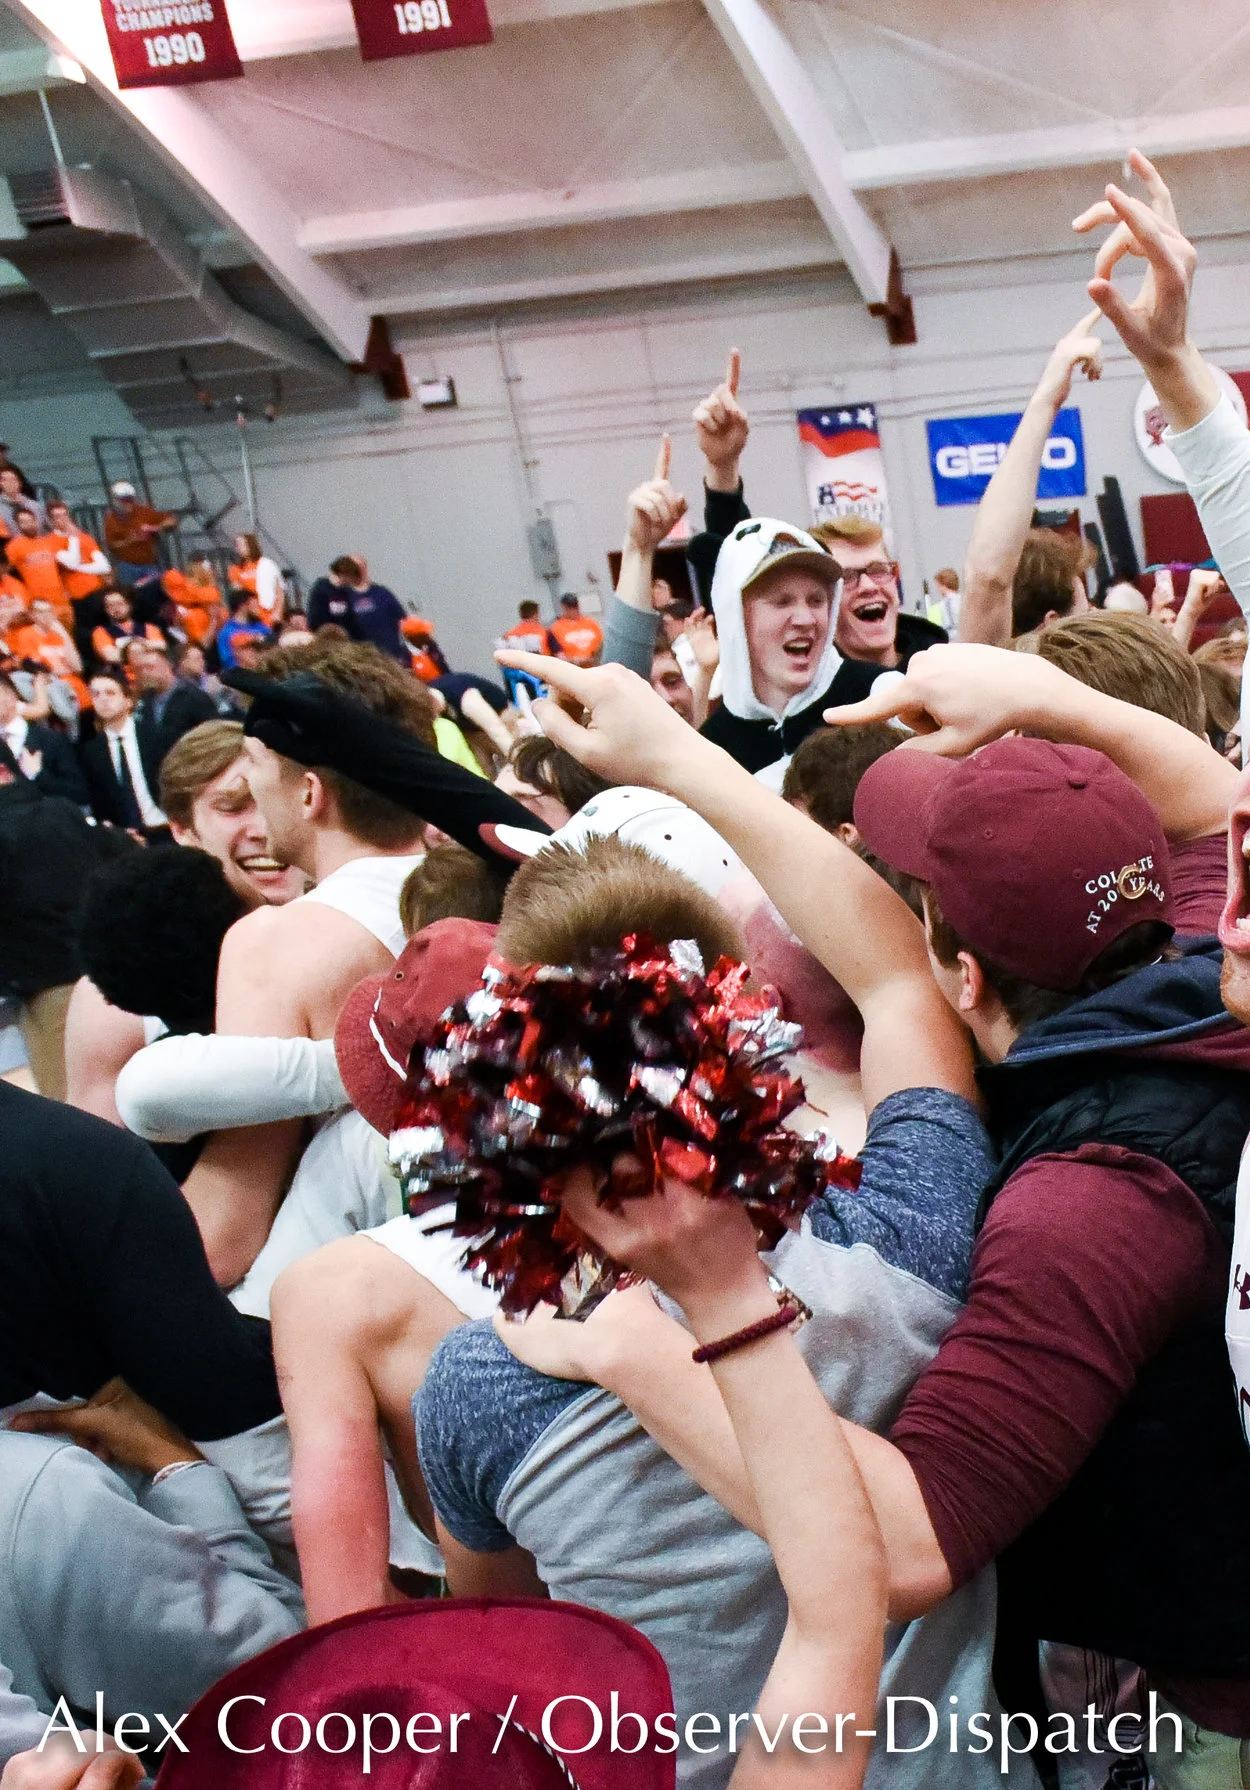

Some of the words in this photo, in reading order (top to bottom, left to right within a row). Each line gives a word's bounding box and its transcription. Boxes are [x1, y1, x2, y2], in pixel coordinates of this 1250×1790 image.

[115, 2, 214, 32] CHAMPIONS
[393, 0, 452, 34] 1991
[143, 31, 206, 67] 1990
[1086, 911, 1101, 934] AT
[1098, 890, 1119, 912] 20
